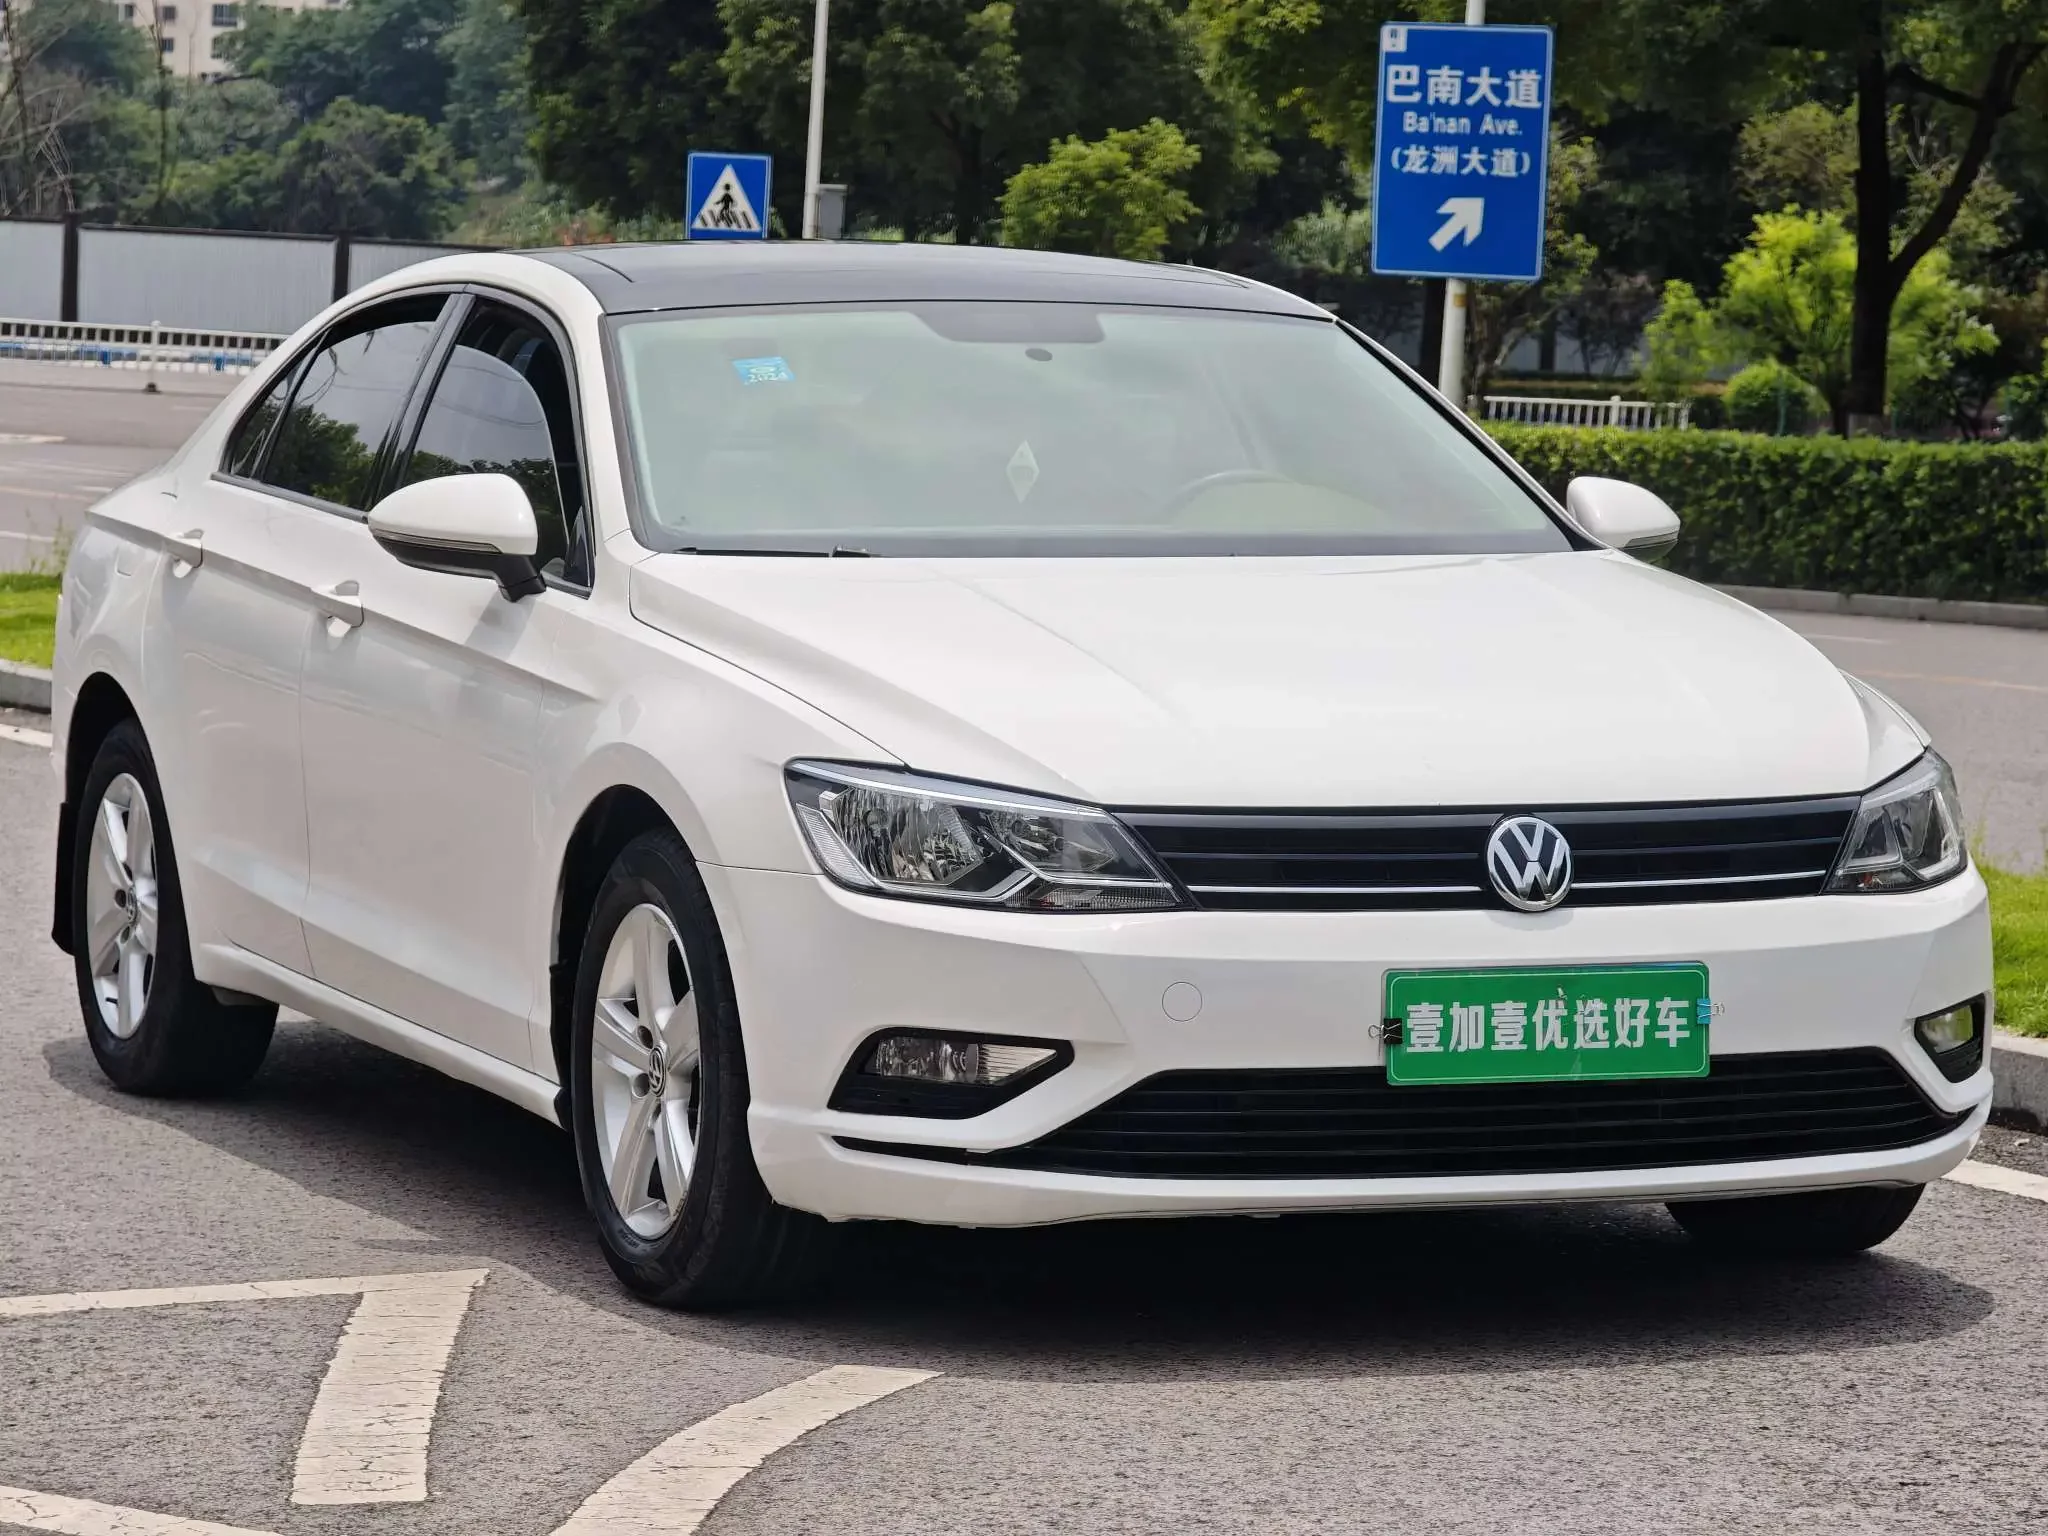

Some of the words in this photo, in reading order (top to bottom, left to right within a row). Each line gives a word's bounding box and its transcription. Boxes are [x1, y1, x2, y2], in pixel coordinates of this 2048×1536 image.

[1386, 64, 1542, 108] 巴南大道
[1403, 111, 1470, 135] Ba'nan
[1479, 114, 1523, 135] Ave.
[1406, 997, 1690, 1053] 壹加壹优选好车
